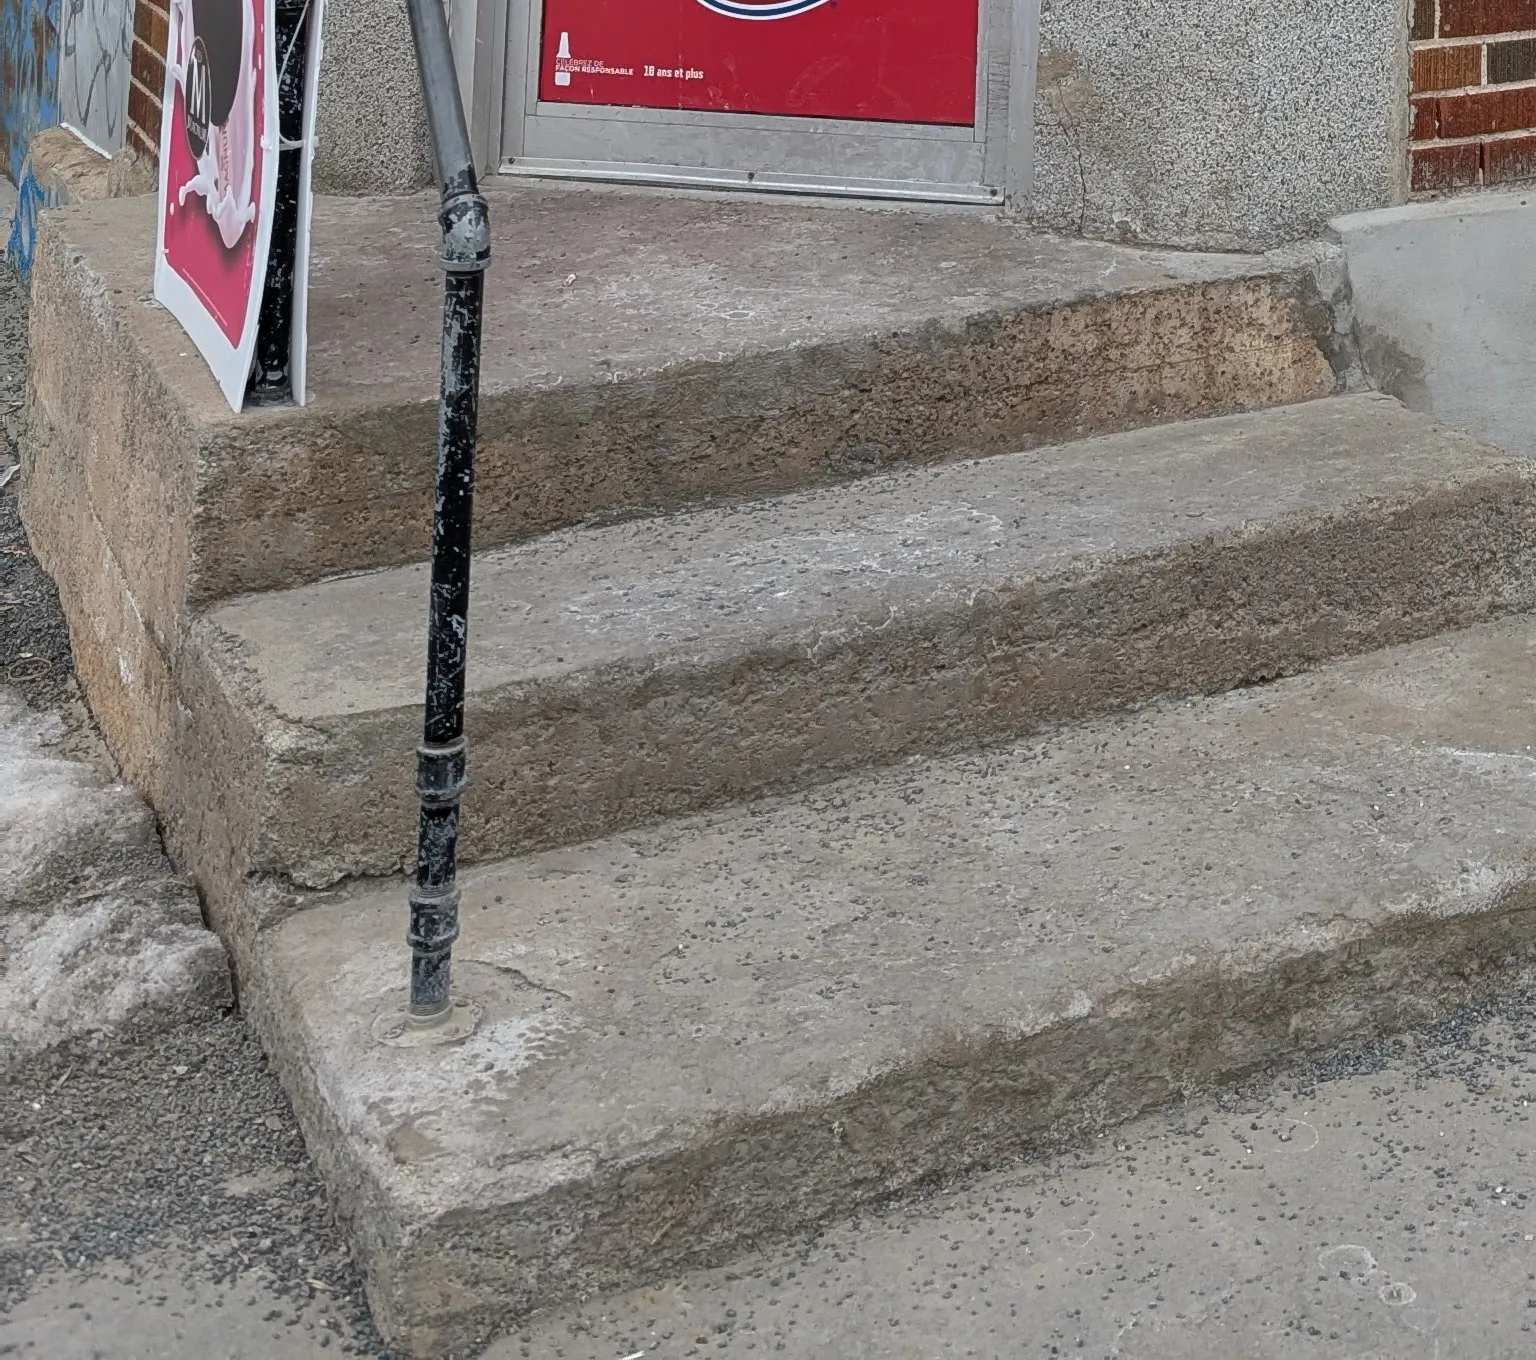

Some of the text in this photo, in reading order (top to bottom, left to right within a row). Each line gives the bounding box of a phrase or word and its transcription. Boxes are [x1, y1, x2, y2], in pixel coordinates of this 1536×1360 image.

[644, 65, 704, 80] 18 ans et plus
